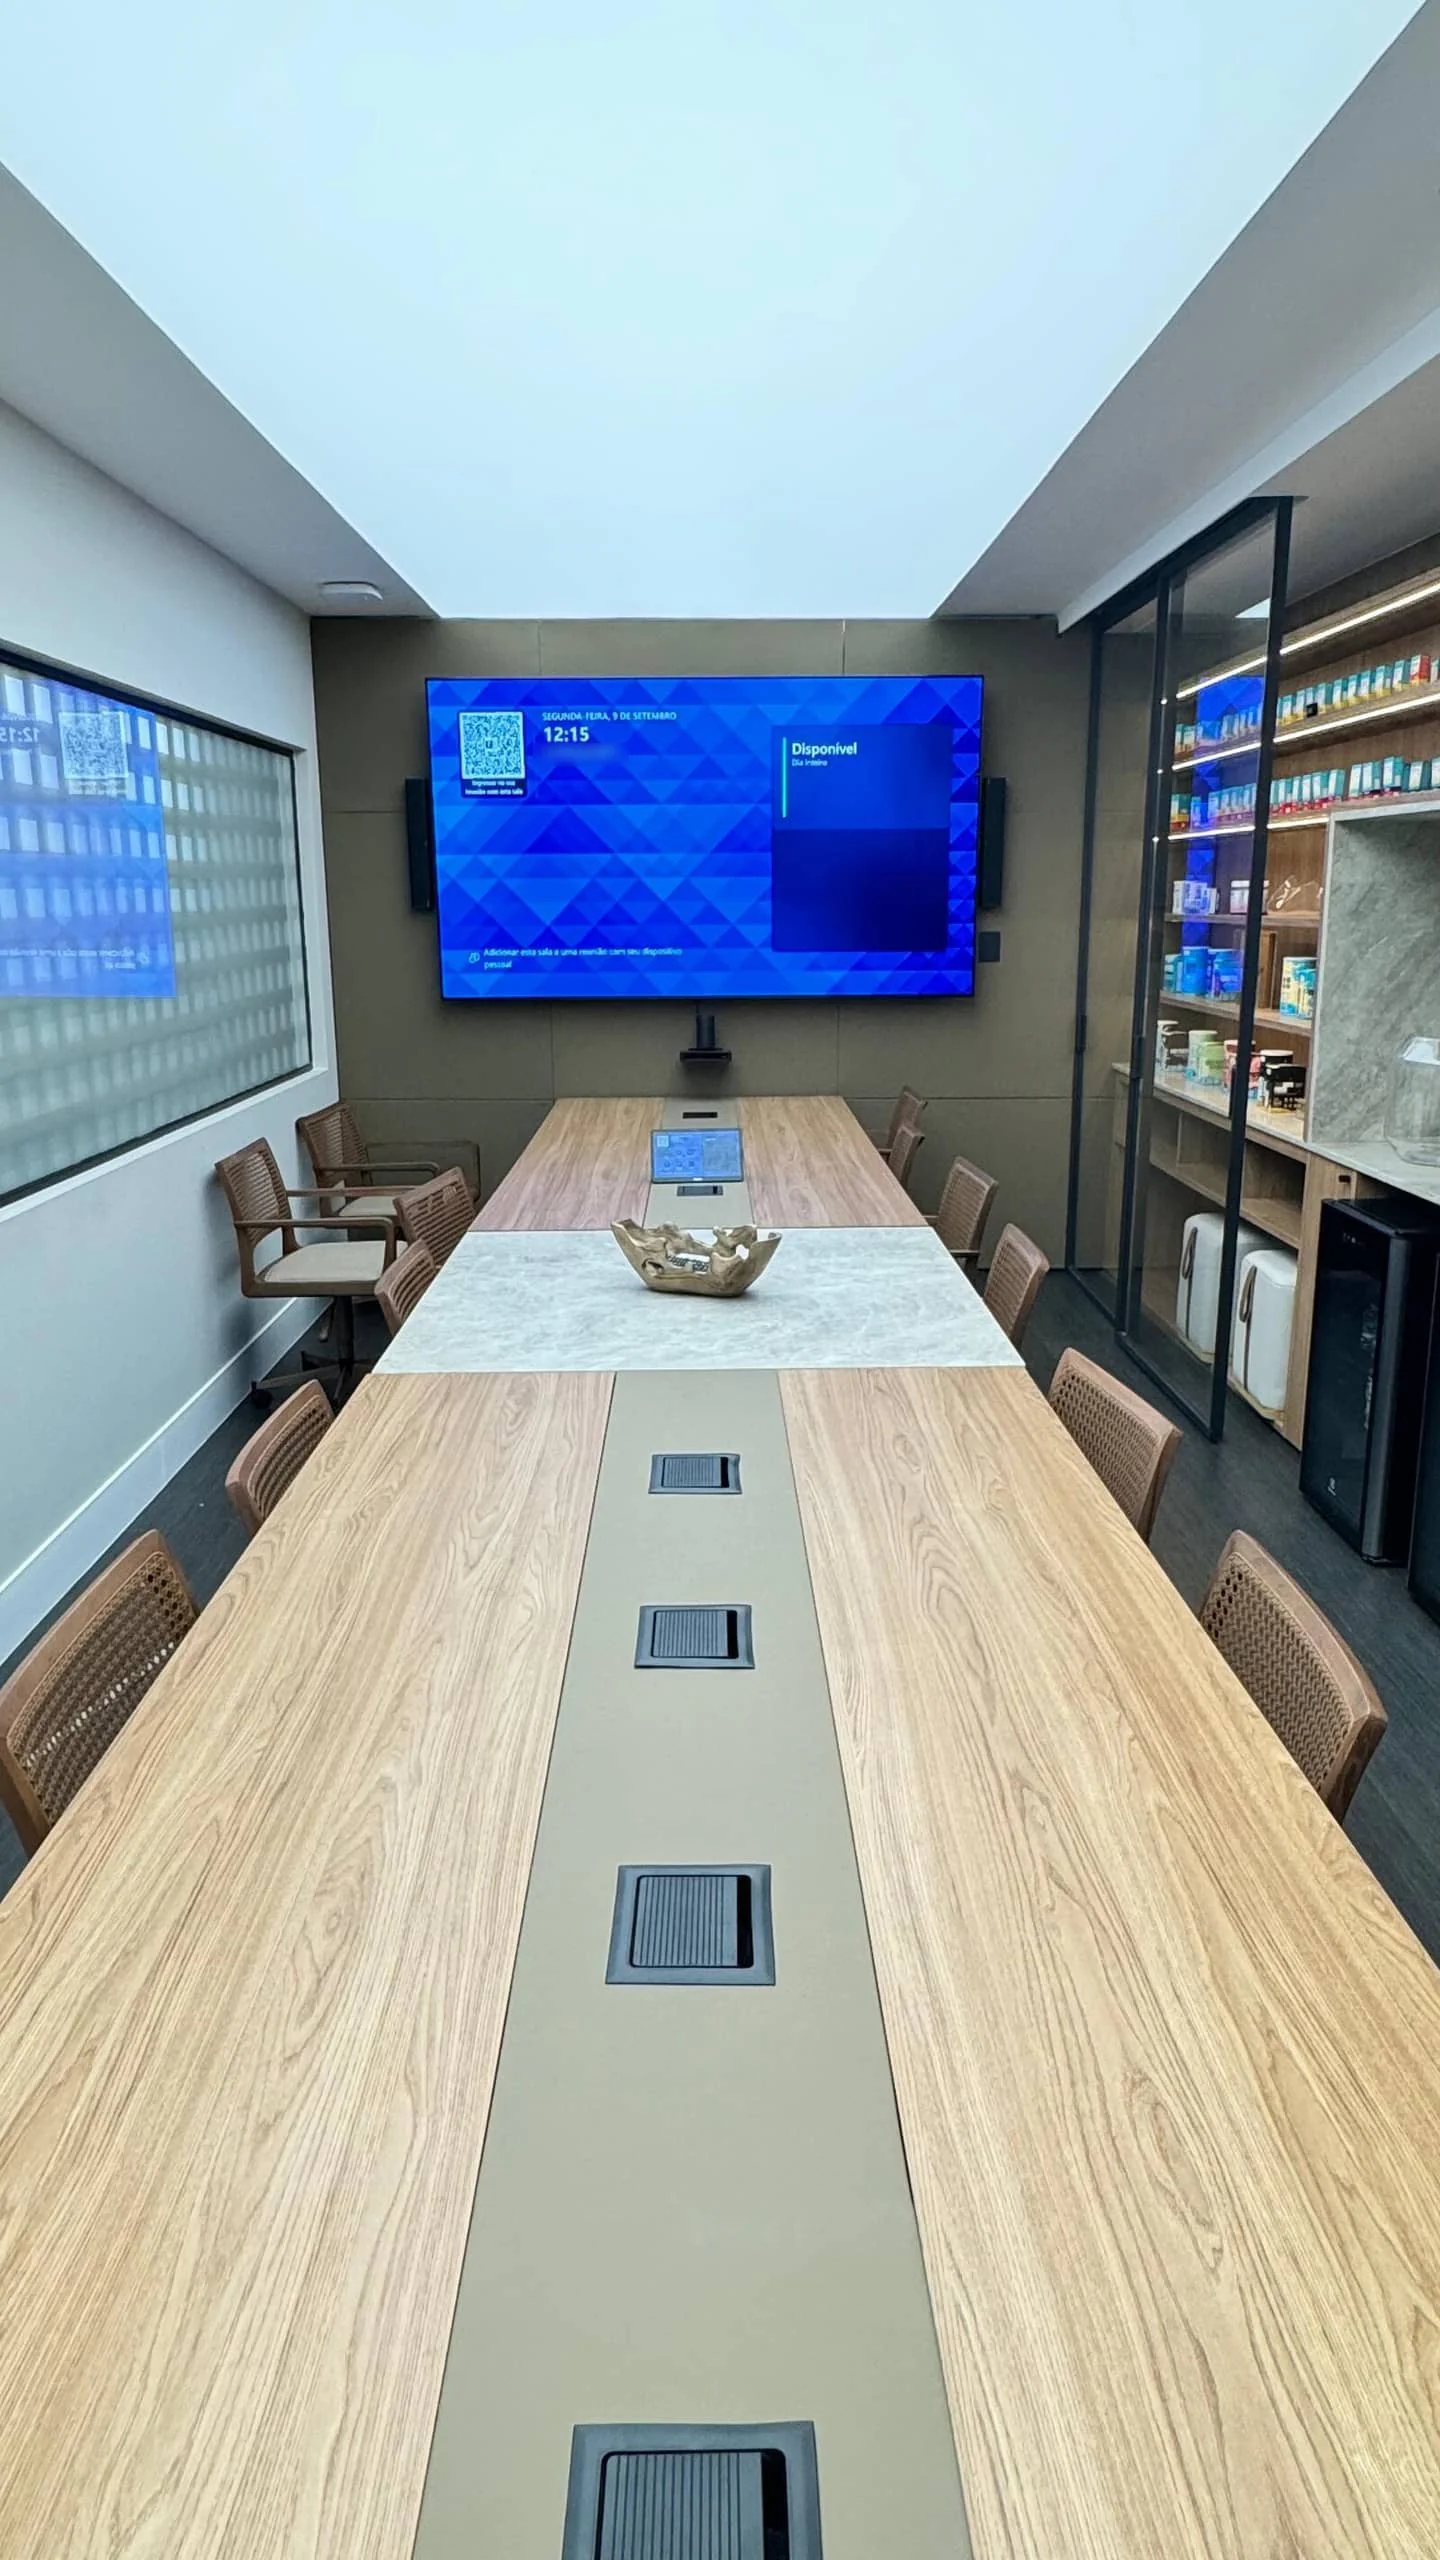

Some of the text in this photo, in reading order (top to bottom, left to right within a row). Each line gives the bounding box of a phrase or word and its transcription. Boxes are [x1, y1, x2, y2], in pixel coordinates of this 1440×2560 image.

[612, 711, 618, 721] 9
[620, 711, 630, 721] DE
[633, 711, 677, 721] SETEMBRO
[544, 726, 590, 743] 12:15
[792, 741, 857, 758] Disponível
